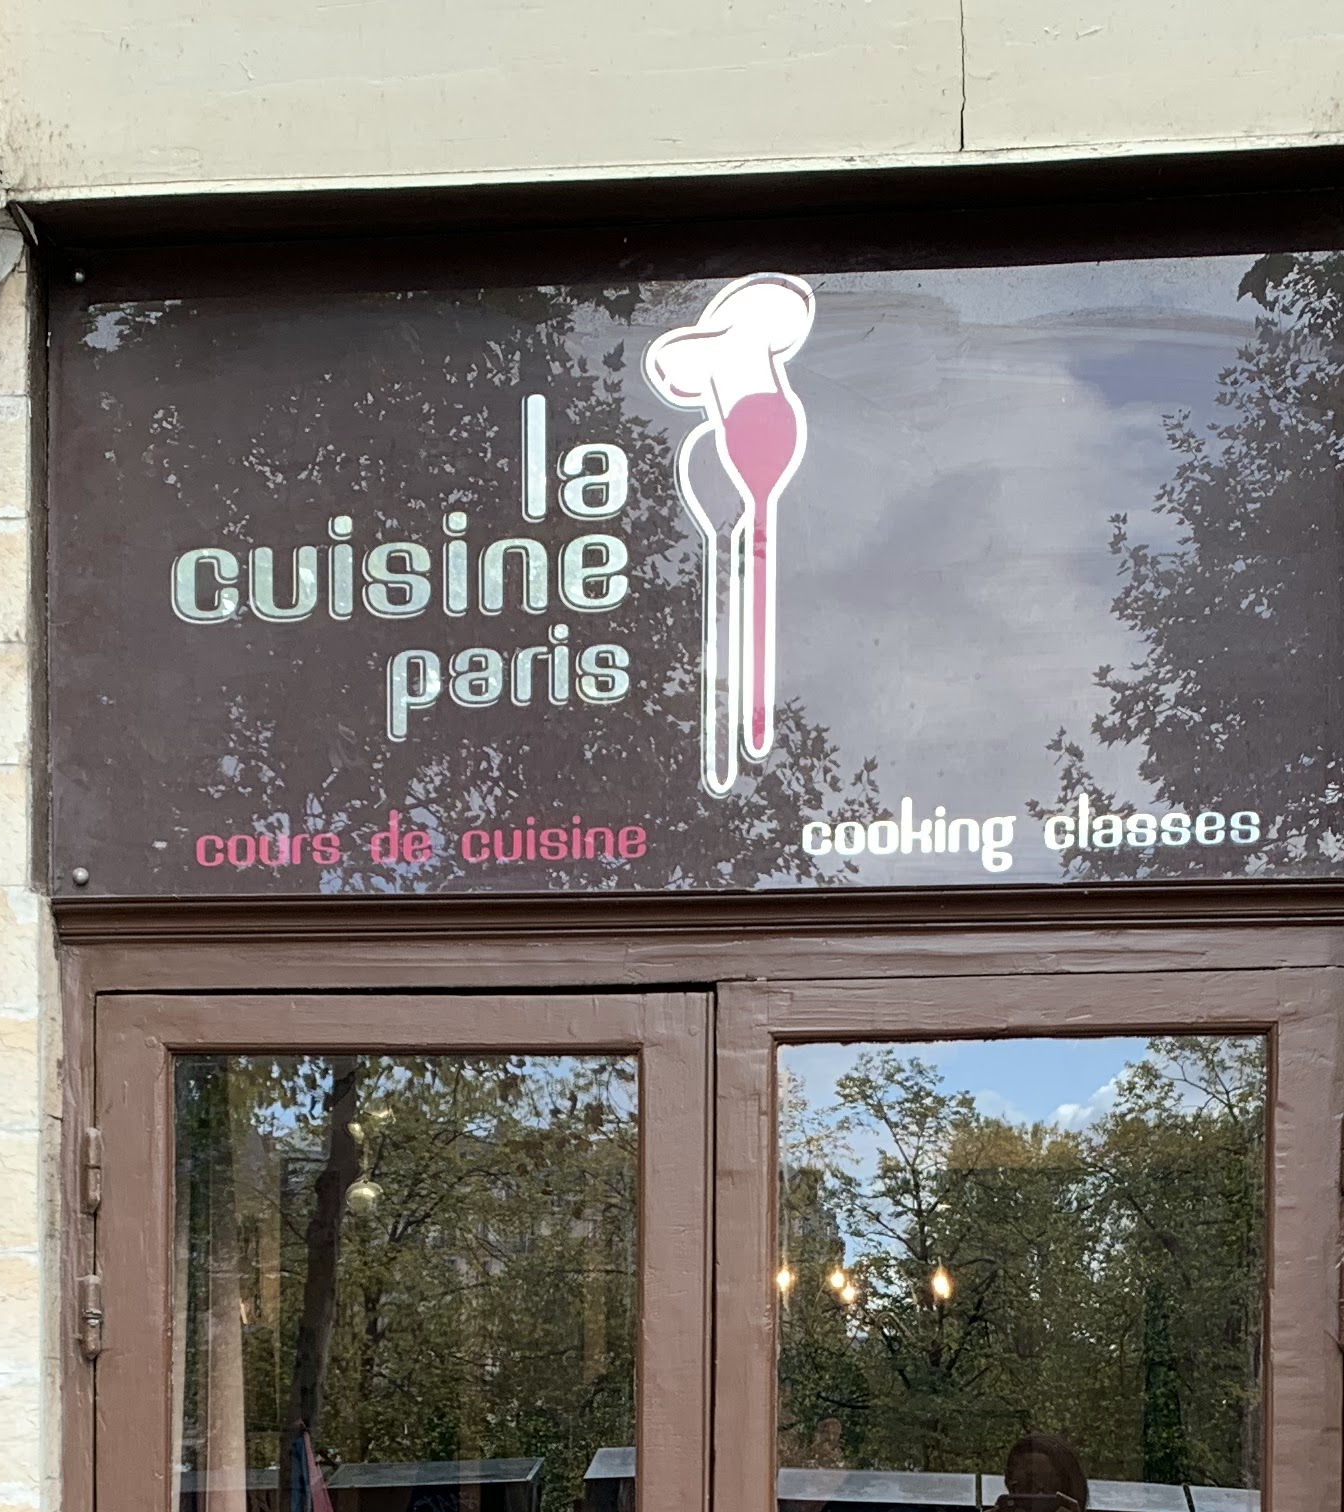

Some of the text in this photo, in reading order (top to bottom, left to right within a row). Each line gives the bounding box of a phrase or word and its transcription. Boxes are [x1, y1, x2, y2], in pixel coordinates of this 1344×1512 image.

[521, 393, 629, 523] la
[171, 511, 629, 624] cuisine
[387, 623, 630, 742] paris
[195, 810, 647, 867] cours de cuisine
[802, 793, 1260, 873] cooking classes
